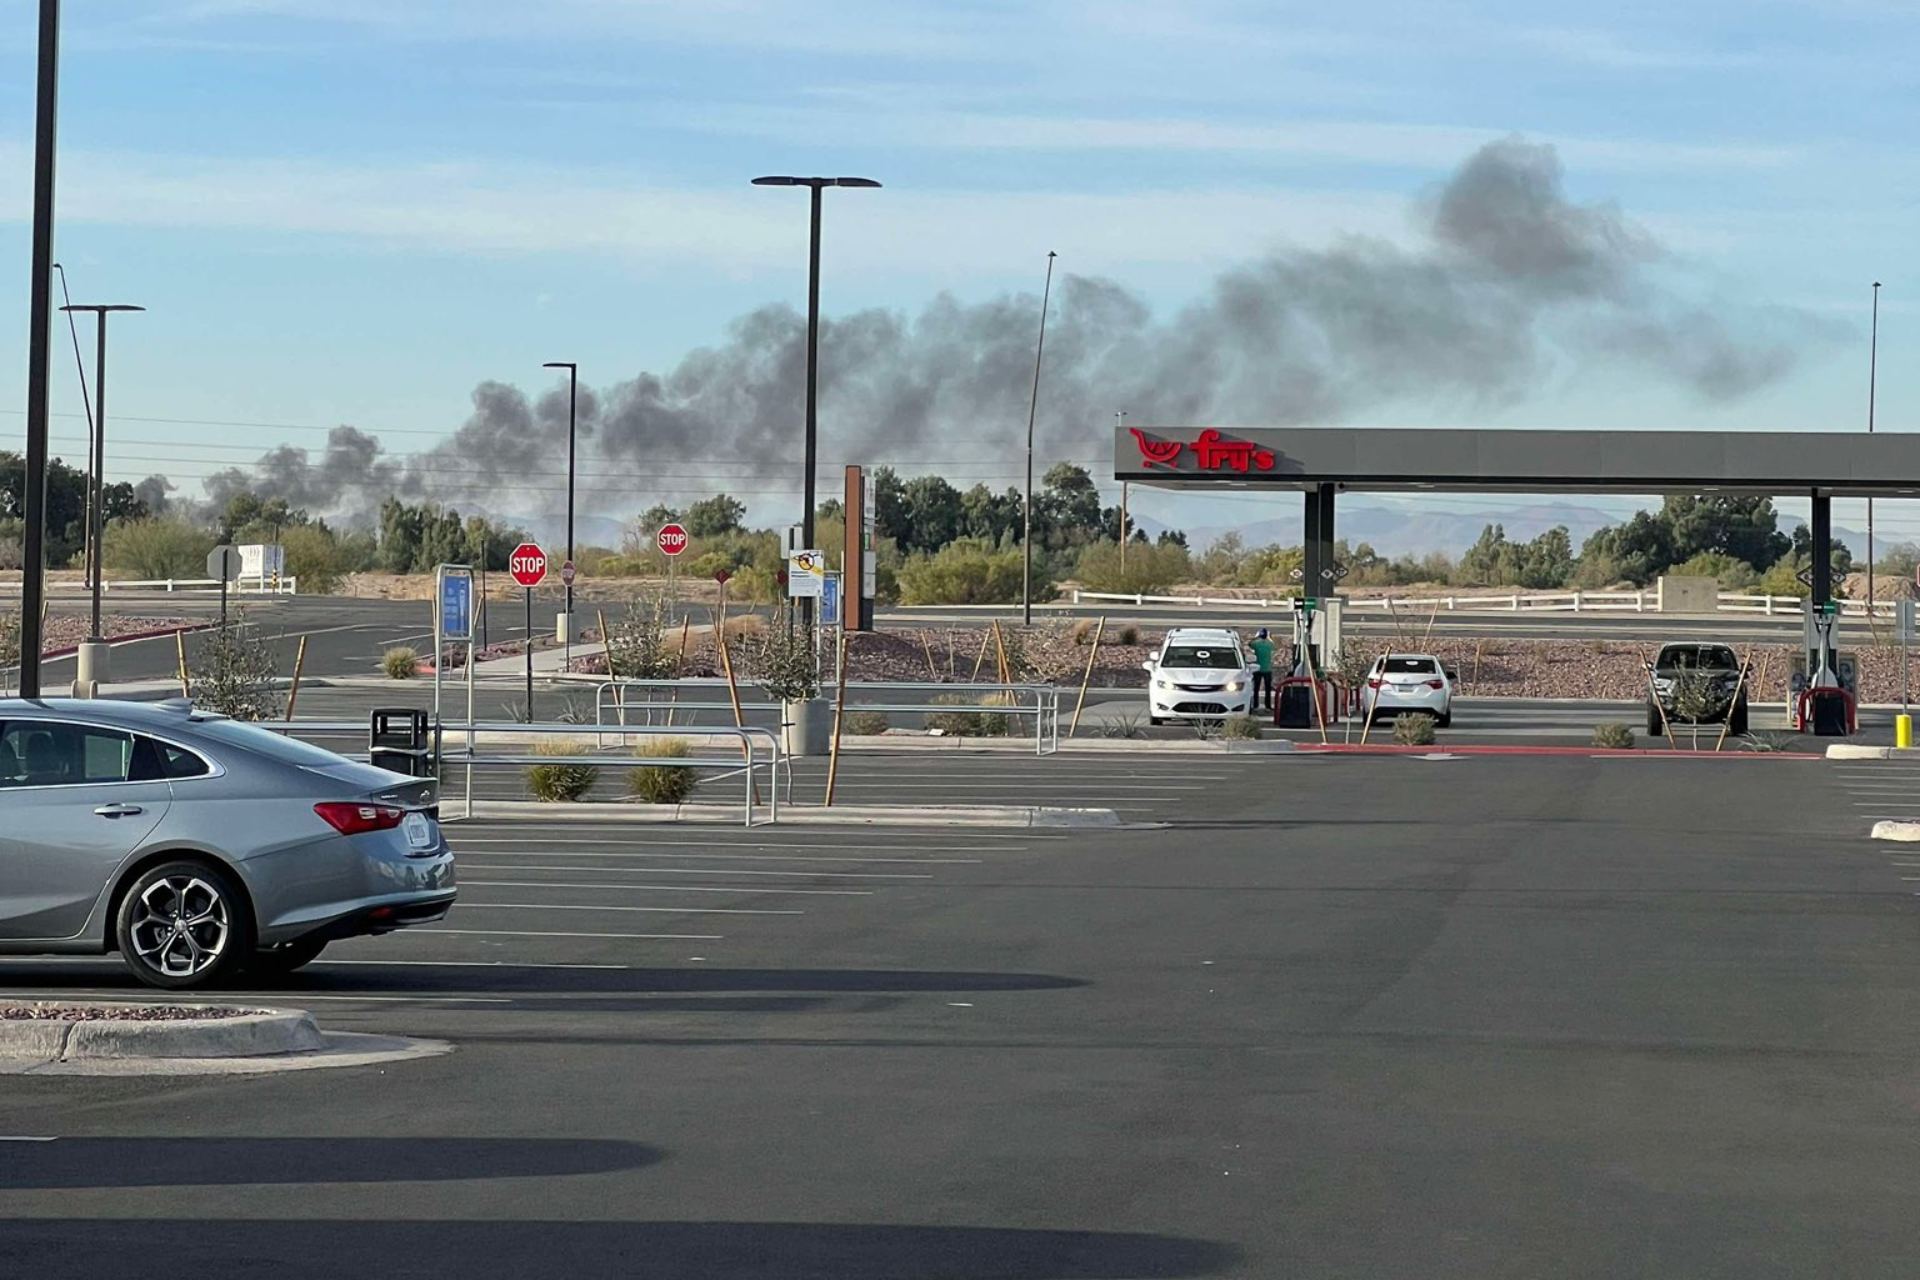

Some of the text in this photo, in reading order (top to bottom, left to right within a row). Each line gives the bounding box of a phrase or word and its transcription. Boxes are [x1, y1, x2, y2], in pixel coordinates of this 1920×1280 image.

[1189, 428, 1275, 472] fry's
[660, 533, 685, 545] STOP
[512, 557, 544, 573] STOP
